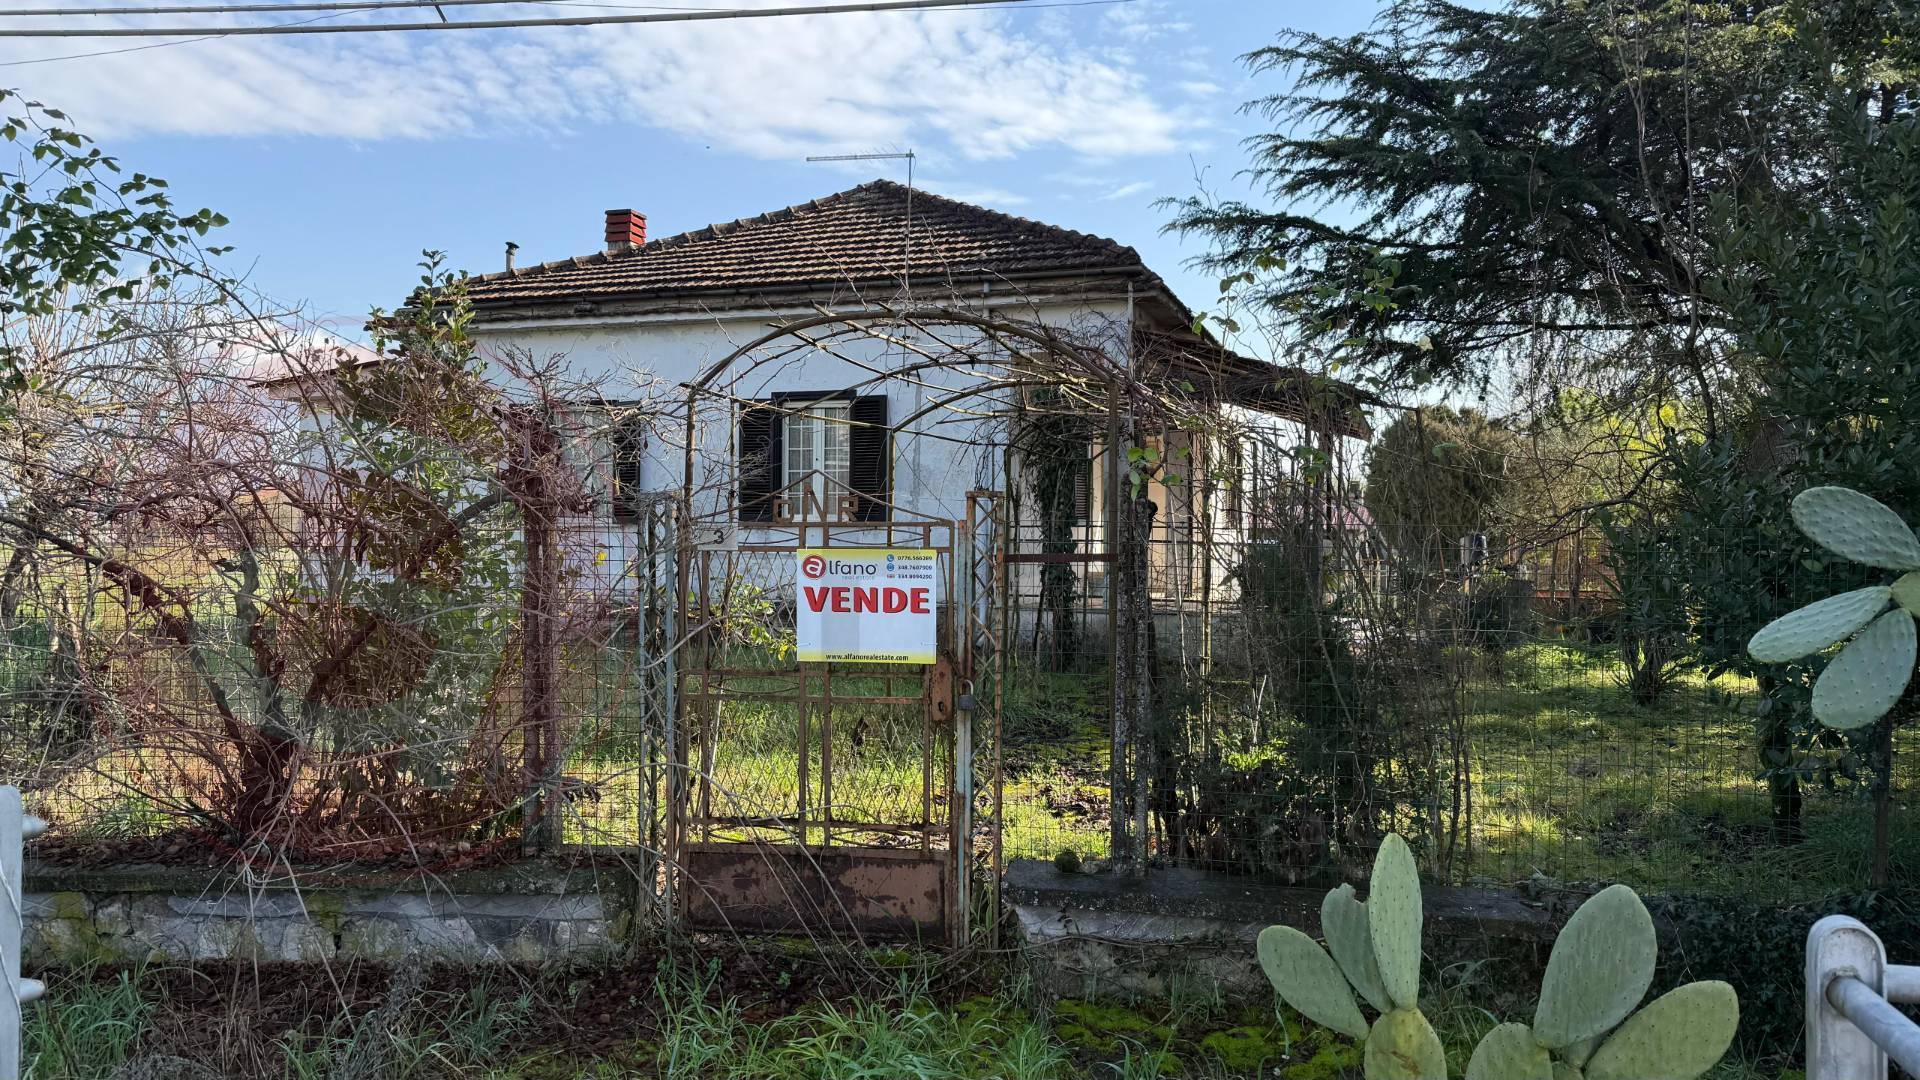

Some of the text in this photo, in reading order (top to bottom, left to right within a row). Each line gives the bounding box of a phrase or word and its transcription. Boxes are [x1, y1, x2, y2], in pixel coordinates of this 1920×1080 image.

[713, 530, 724, 544] 3
[803, 586, 930, 614] VENDE
[825, 653, 909, 661] www.alfanorealestate.com
